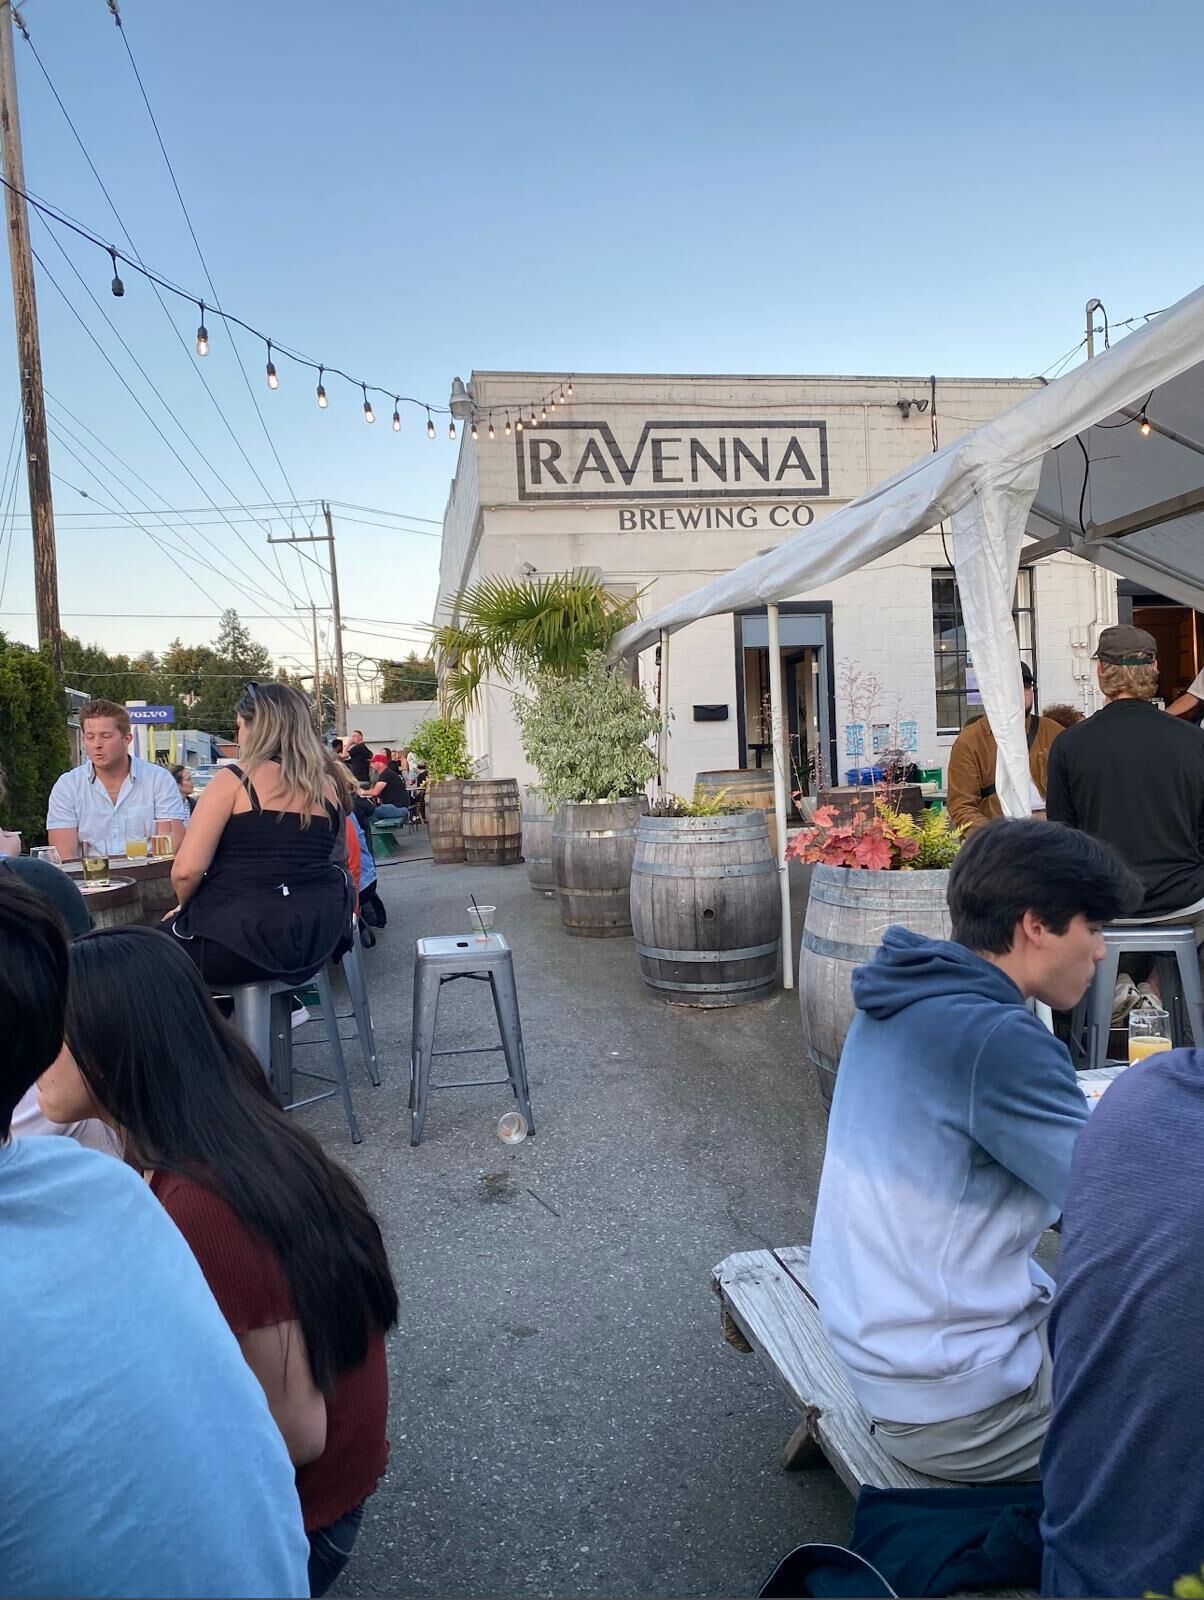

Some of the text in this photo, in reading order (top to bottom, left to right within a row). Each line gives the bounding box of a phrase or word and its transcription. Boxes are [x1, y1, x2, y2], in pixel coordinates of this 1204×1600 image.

[528, 421, 817, 486] RAVENNA
[618, 504, 815, 531] BREWING CO
